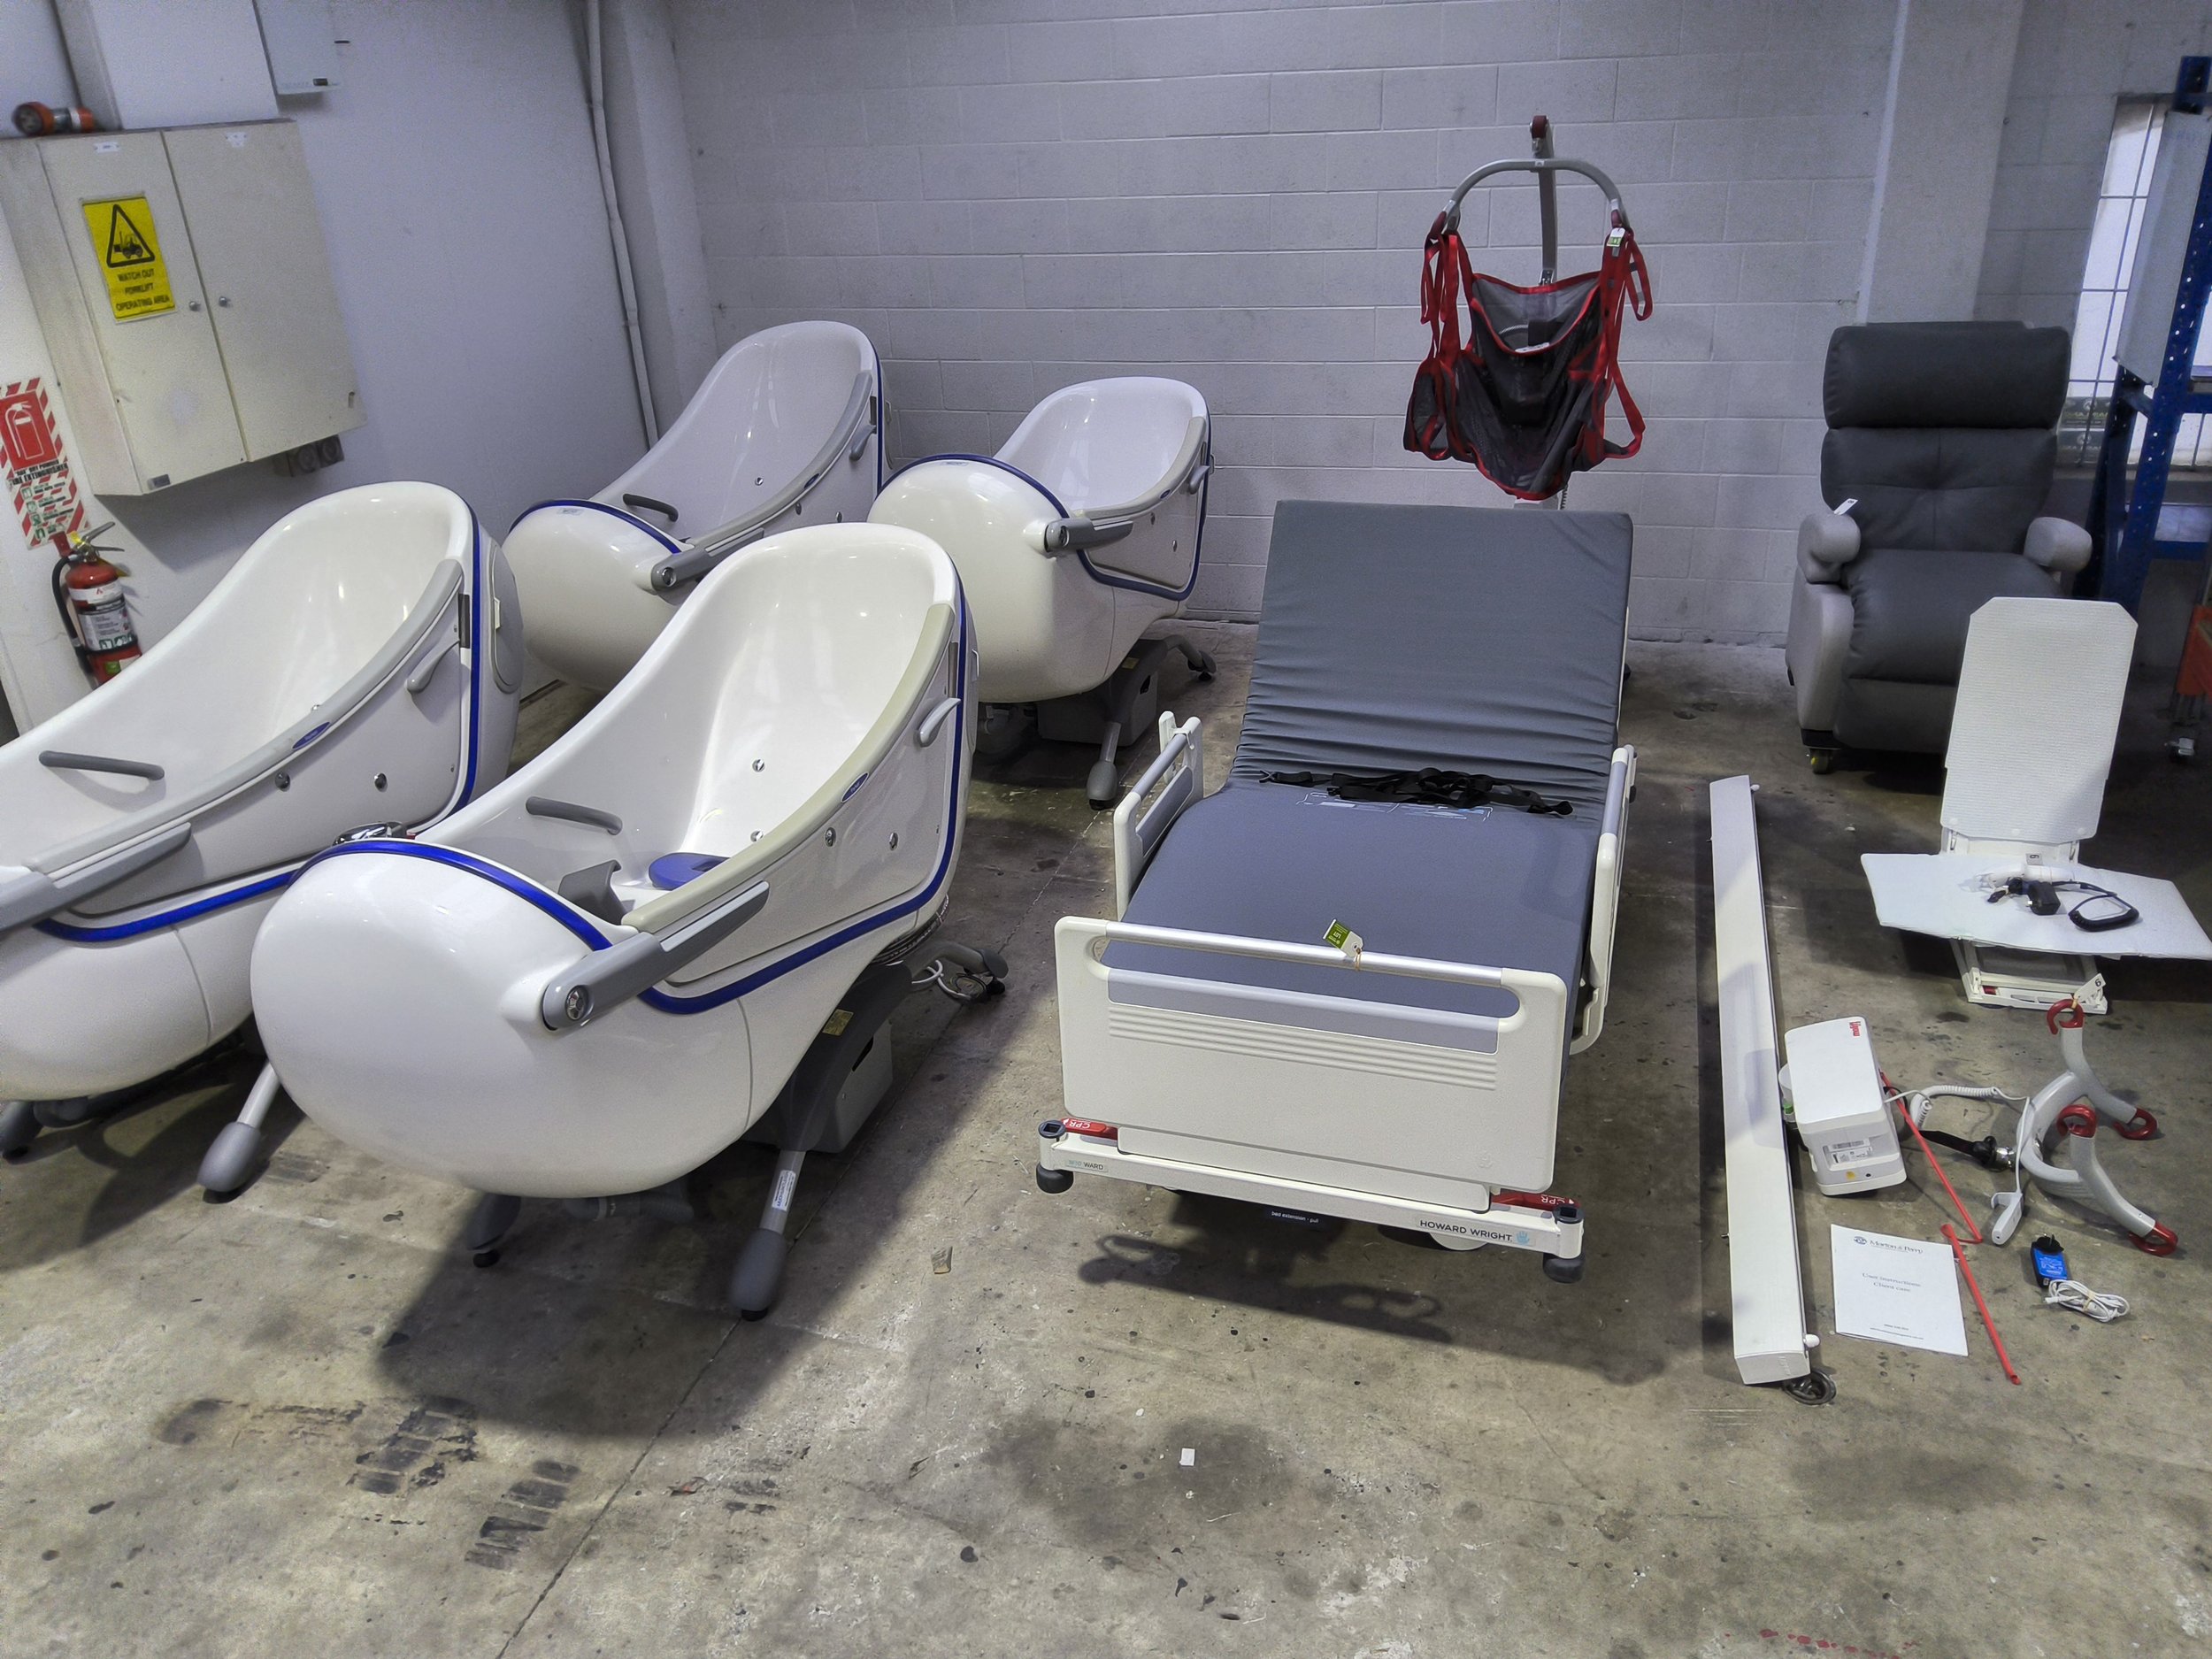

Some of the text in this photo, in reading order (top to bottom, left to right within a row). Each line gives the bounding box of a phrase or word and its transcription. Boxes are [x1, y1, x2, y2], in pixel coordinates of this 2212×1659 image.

[118, 268, 155, 281] WATCH OUT
[125, 282, 154, 295] FORKLIFT
[116, 294, 170, 311] OPERATING AREA
[1069, 1119, 1091, 1129] CPR
[1084, 1162, 1104, 1171] WARD
[1419, 1219, 1511, 1242] HOWARD WRIGHT
[1870, 1240, 1897, 1250] Morton
[1904, 1245, 1924, 1255] Perry
